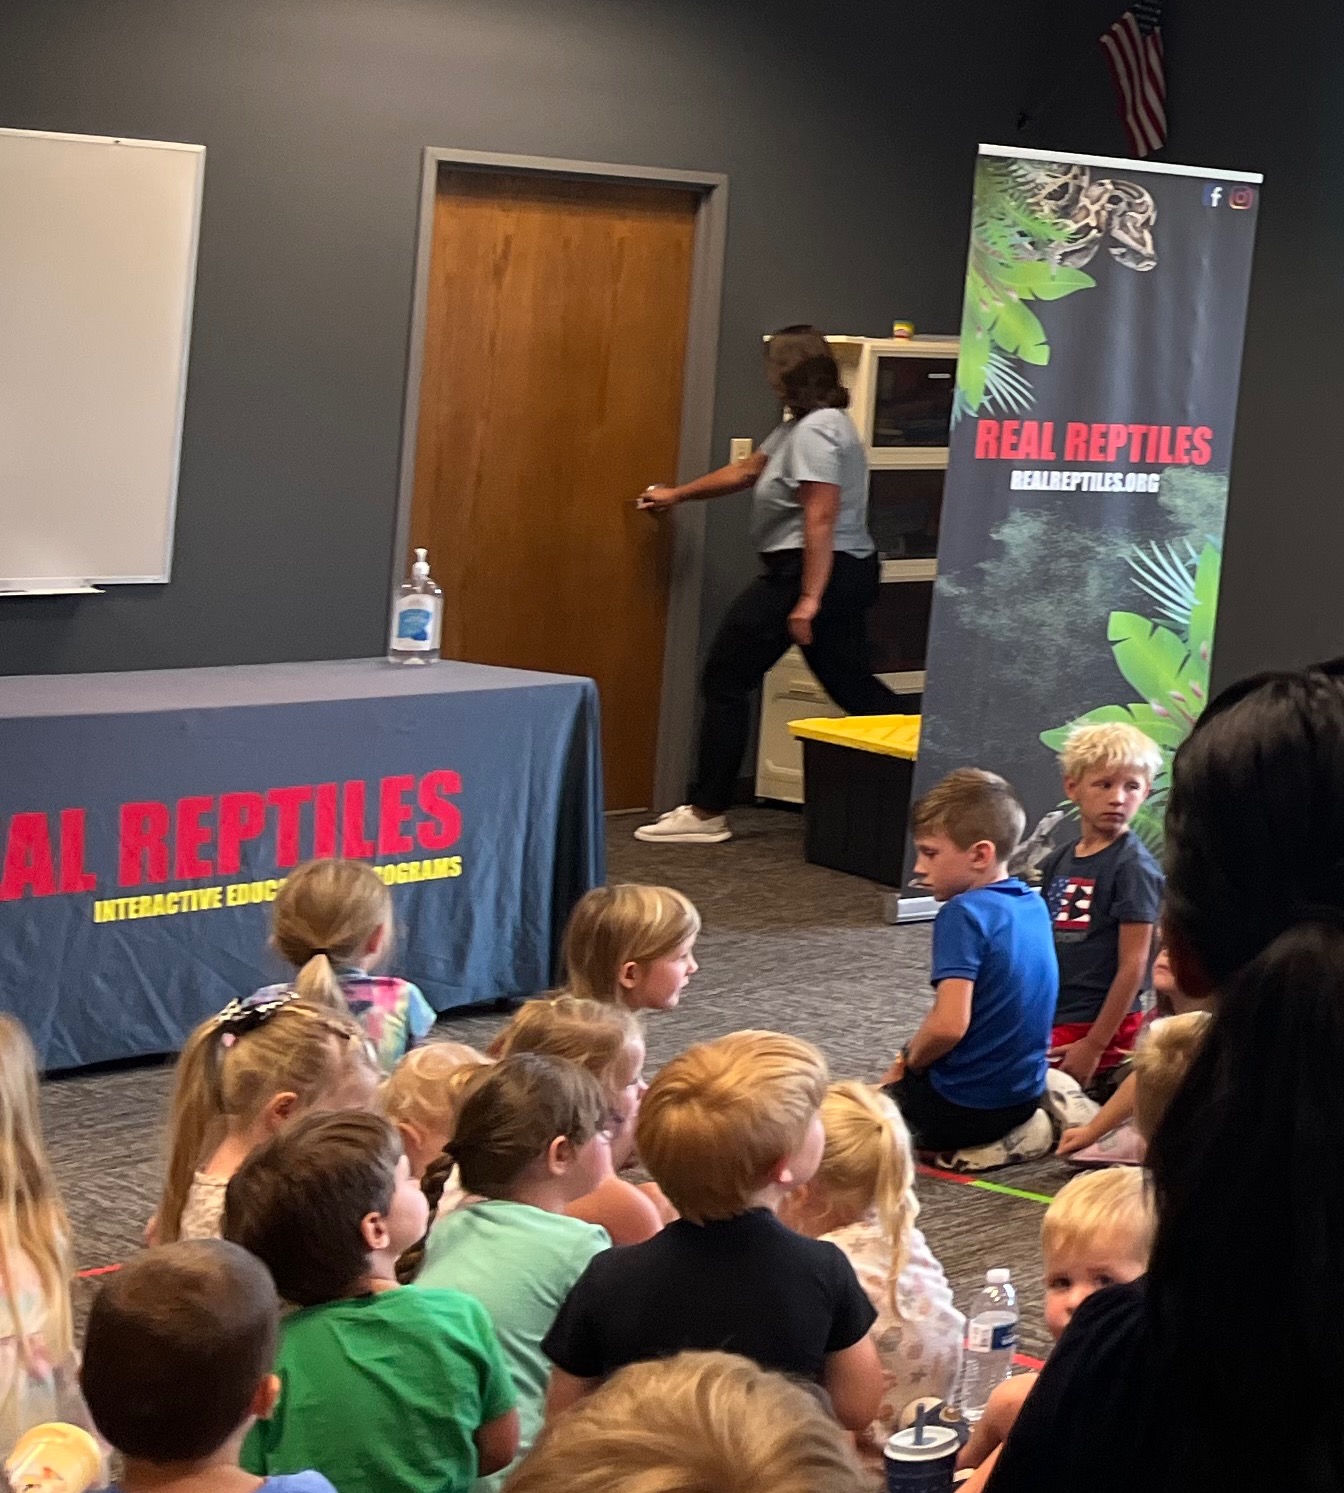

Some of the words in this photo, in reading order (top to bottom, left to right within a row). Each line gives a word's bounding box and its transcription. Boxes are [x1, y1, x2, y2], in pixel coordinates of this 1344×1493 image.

[974, 418, 1057, 461] REAL
[1063, 421, 1214, 466] REPTILES
[1009, 469, 1161, 493] REALREPTILES.ORG
[0, 807, 97, 901] AL
[117, 768, 463, 888] REPTILES
[93, 886, 223, 924] INTERACTIVE
[226, 878, 288, 907] EDUC
